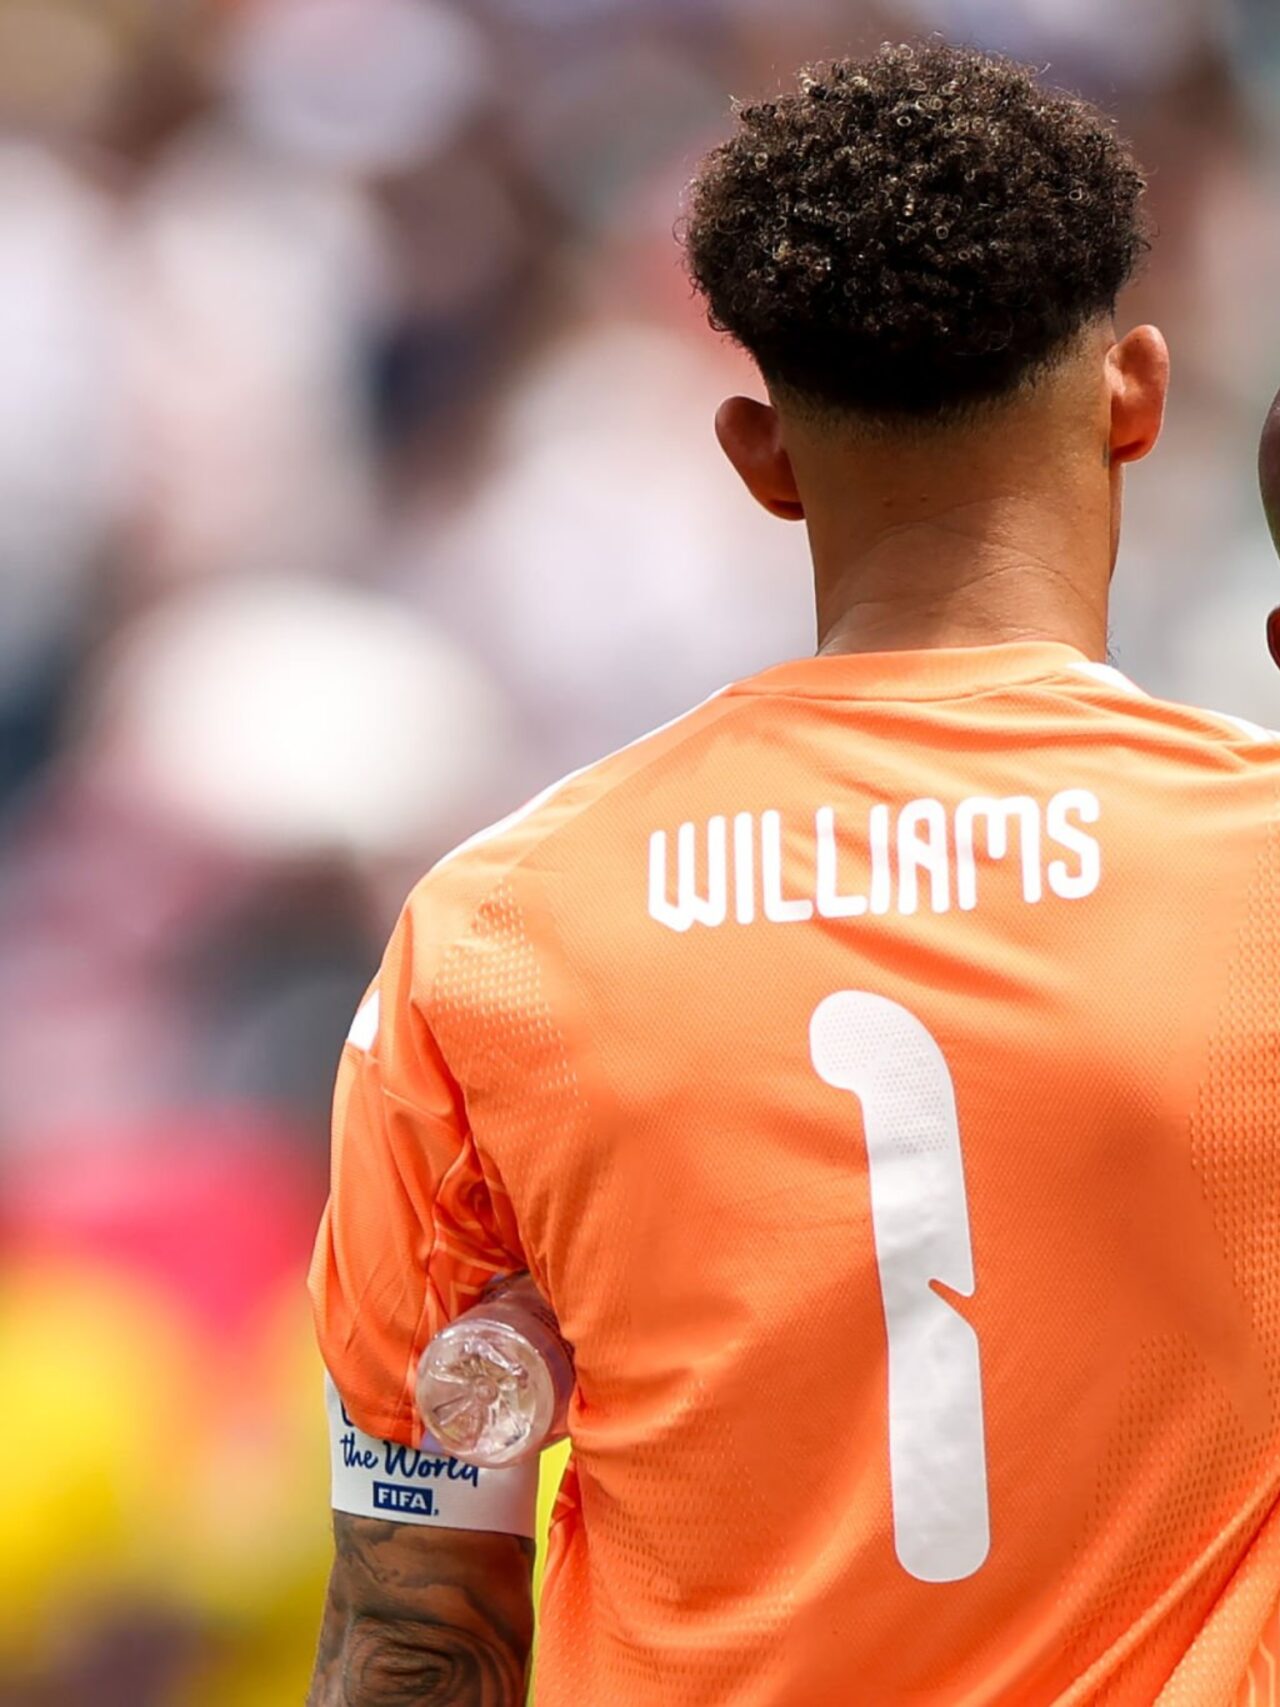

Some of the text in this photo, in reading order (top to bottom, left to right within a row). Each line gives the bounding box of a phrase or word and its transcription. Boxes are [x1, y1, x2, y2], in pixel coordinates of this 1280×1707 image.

[648, 788, 1102, 932] WILLIAMS
[808, 990, 991, 1585] 1
[340, 1432, 378, 1470] the
[377, 1487, 428, 1511] FIFA
